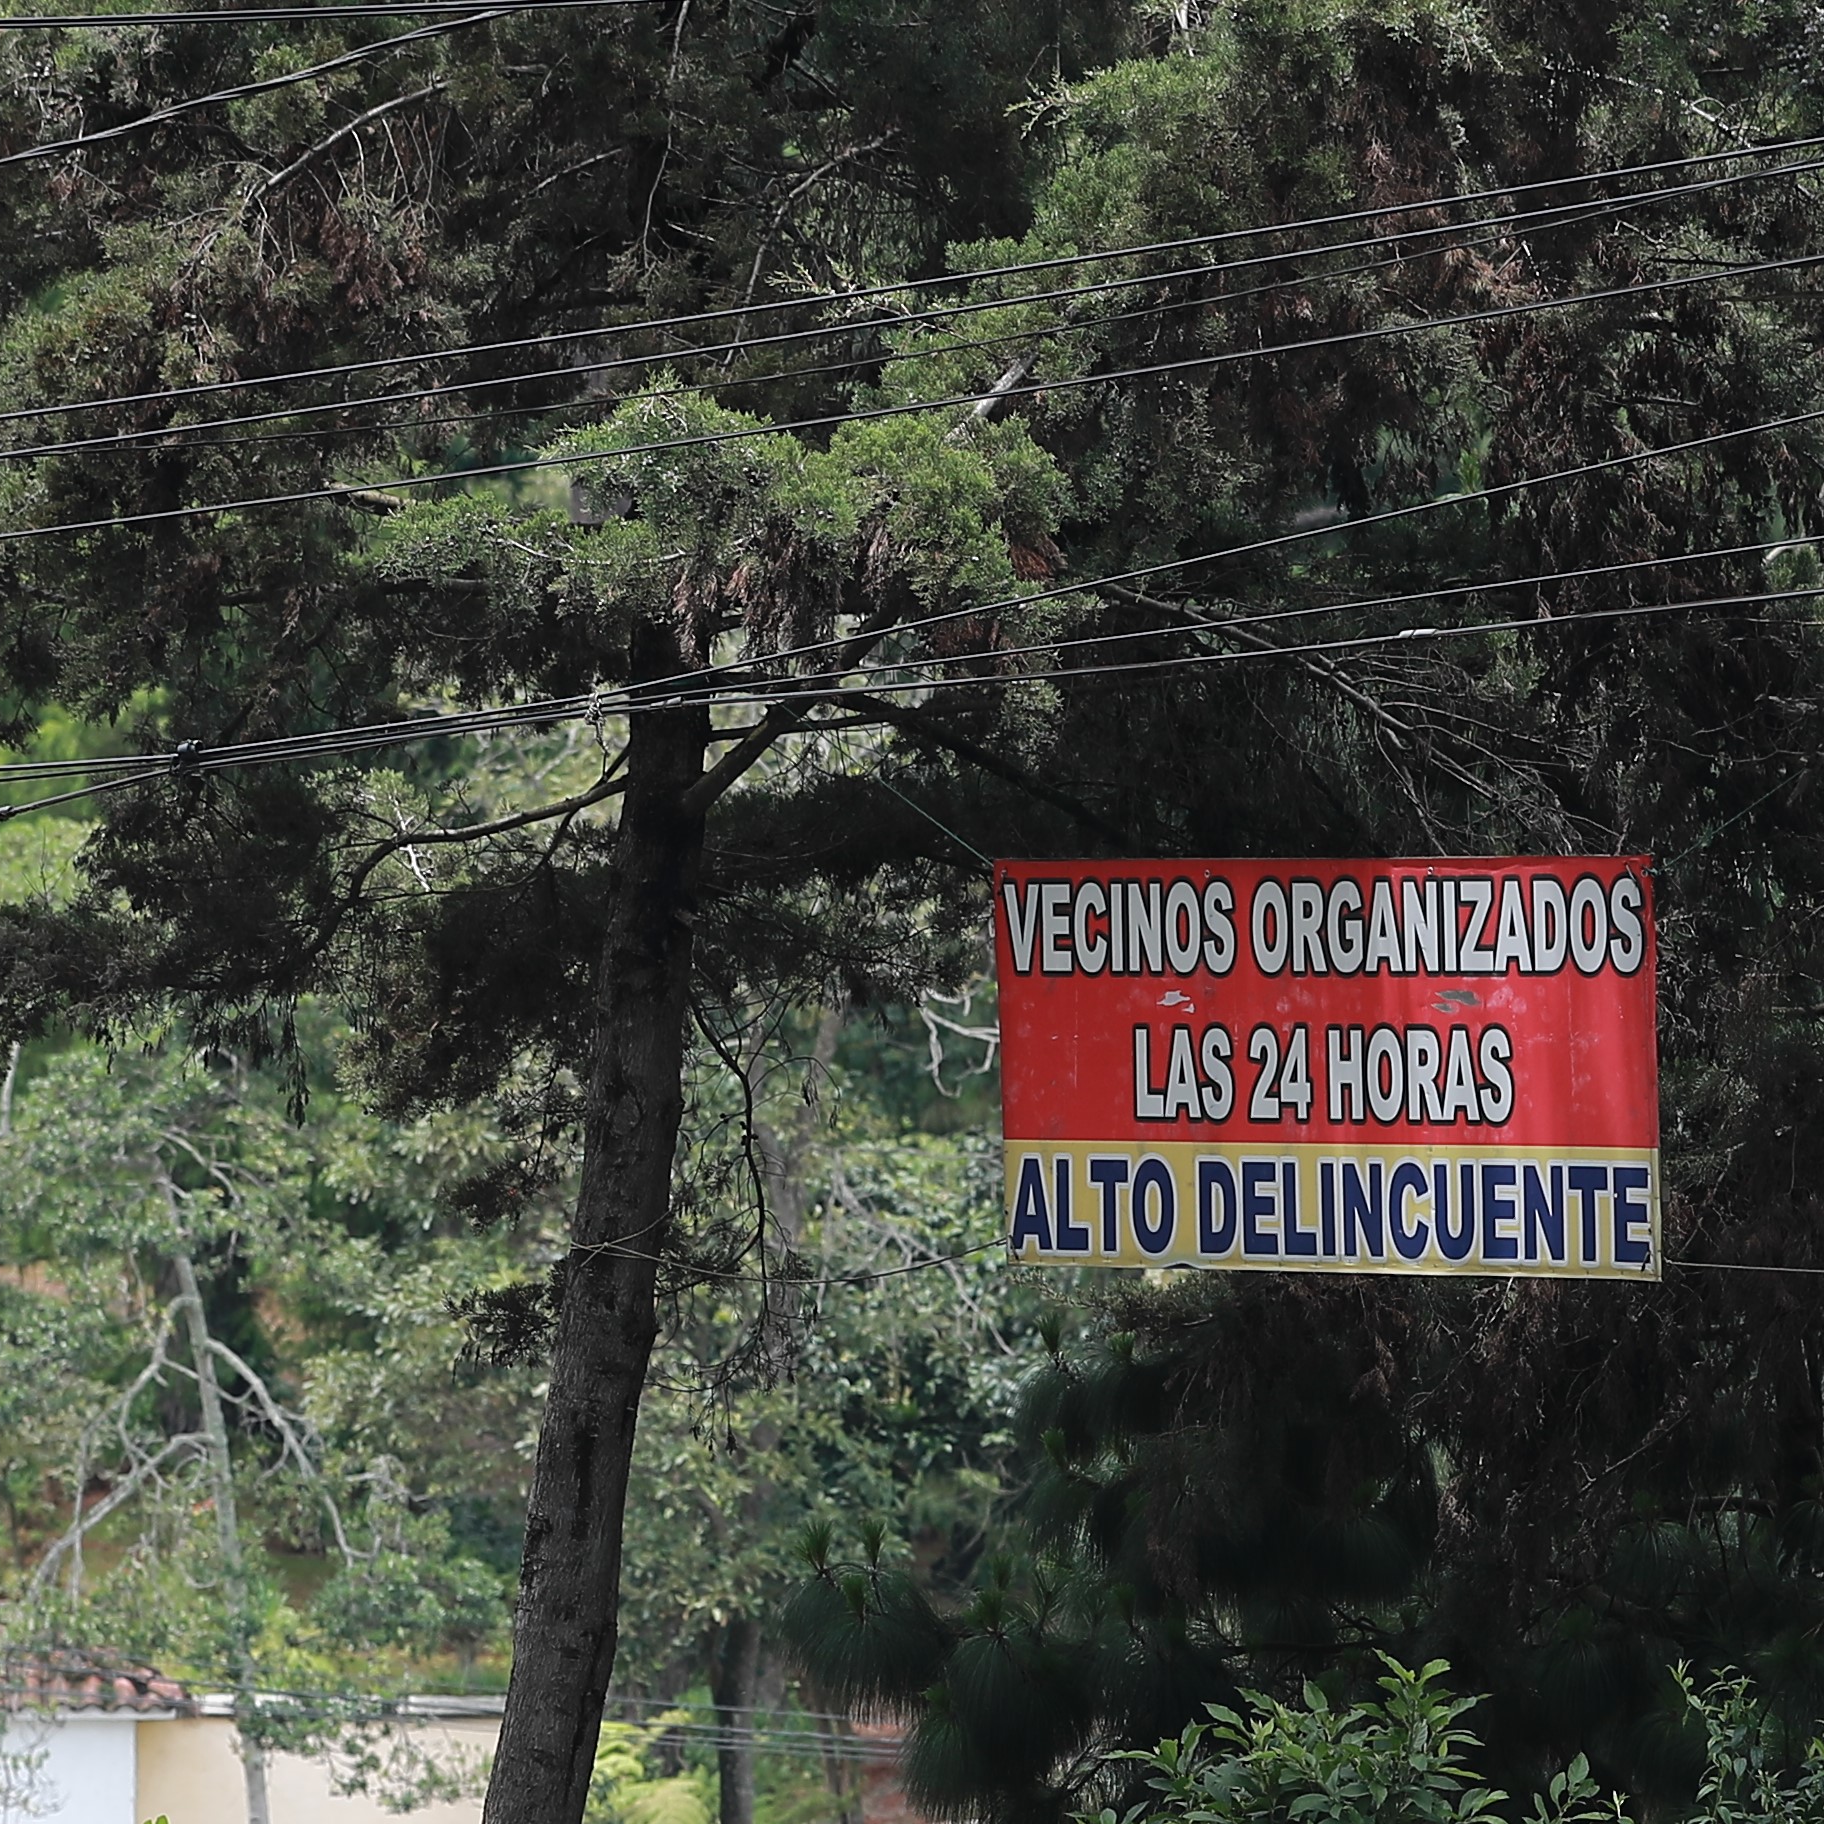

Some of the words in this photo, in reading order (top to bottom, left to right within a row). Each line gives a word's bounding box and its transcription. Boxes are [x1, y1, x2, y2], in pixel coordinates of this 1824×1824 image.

[1002, 877, 1238, 975] VECINOS
[1250, 876, 1645, 976] ORGANIZADOS
[1133, 1024, 1234, 1122] LAS
[1248, 1024, 1312, 1122] 24
[1325, 1024, 1514, 1124] HORAS
[1010, 1152, 1178, 1257] ALTO
[1193, 1154, 1653, 1268] DELINCUENTE
